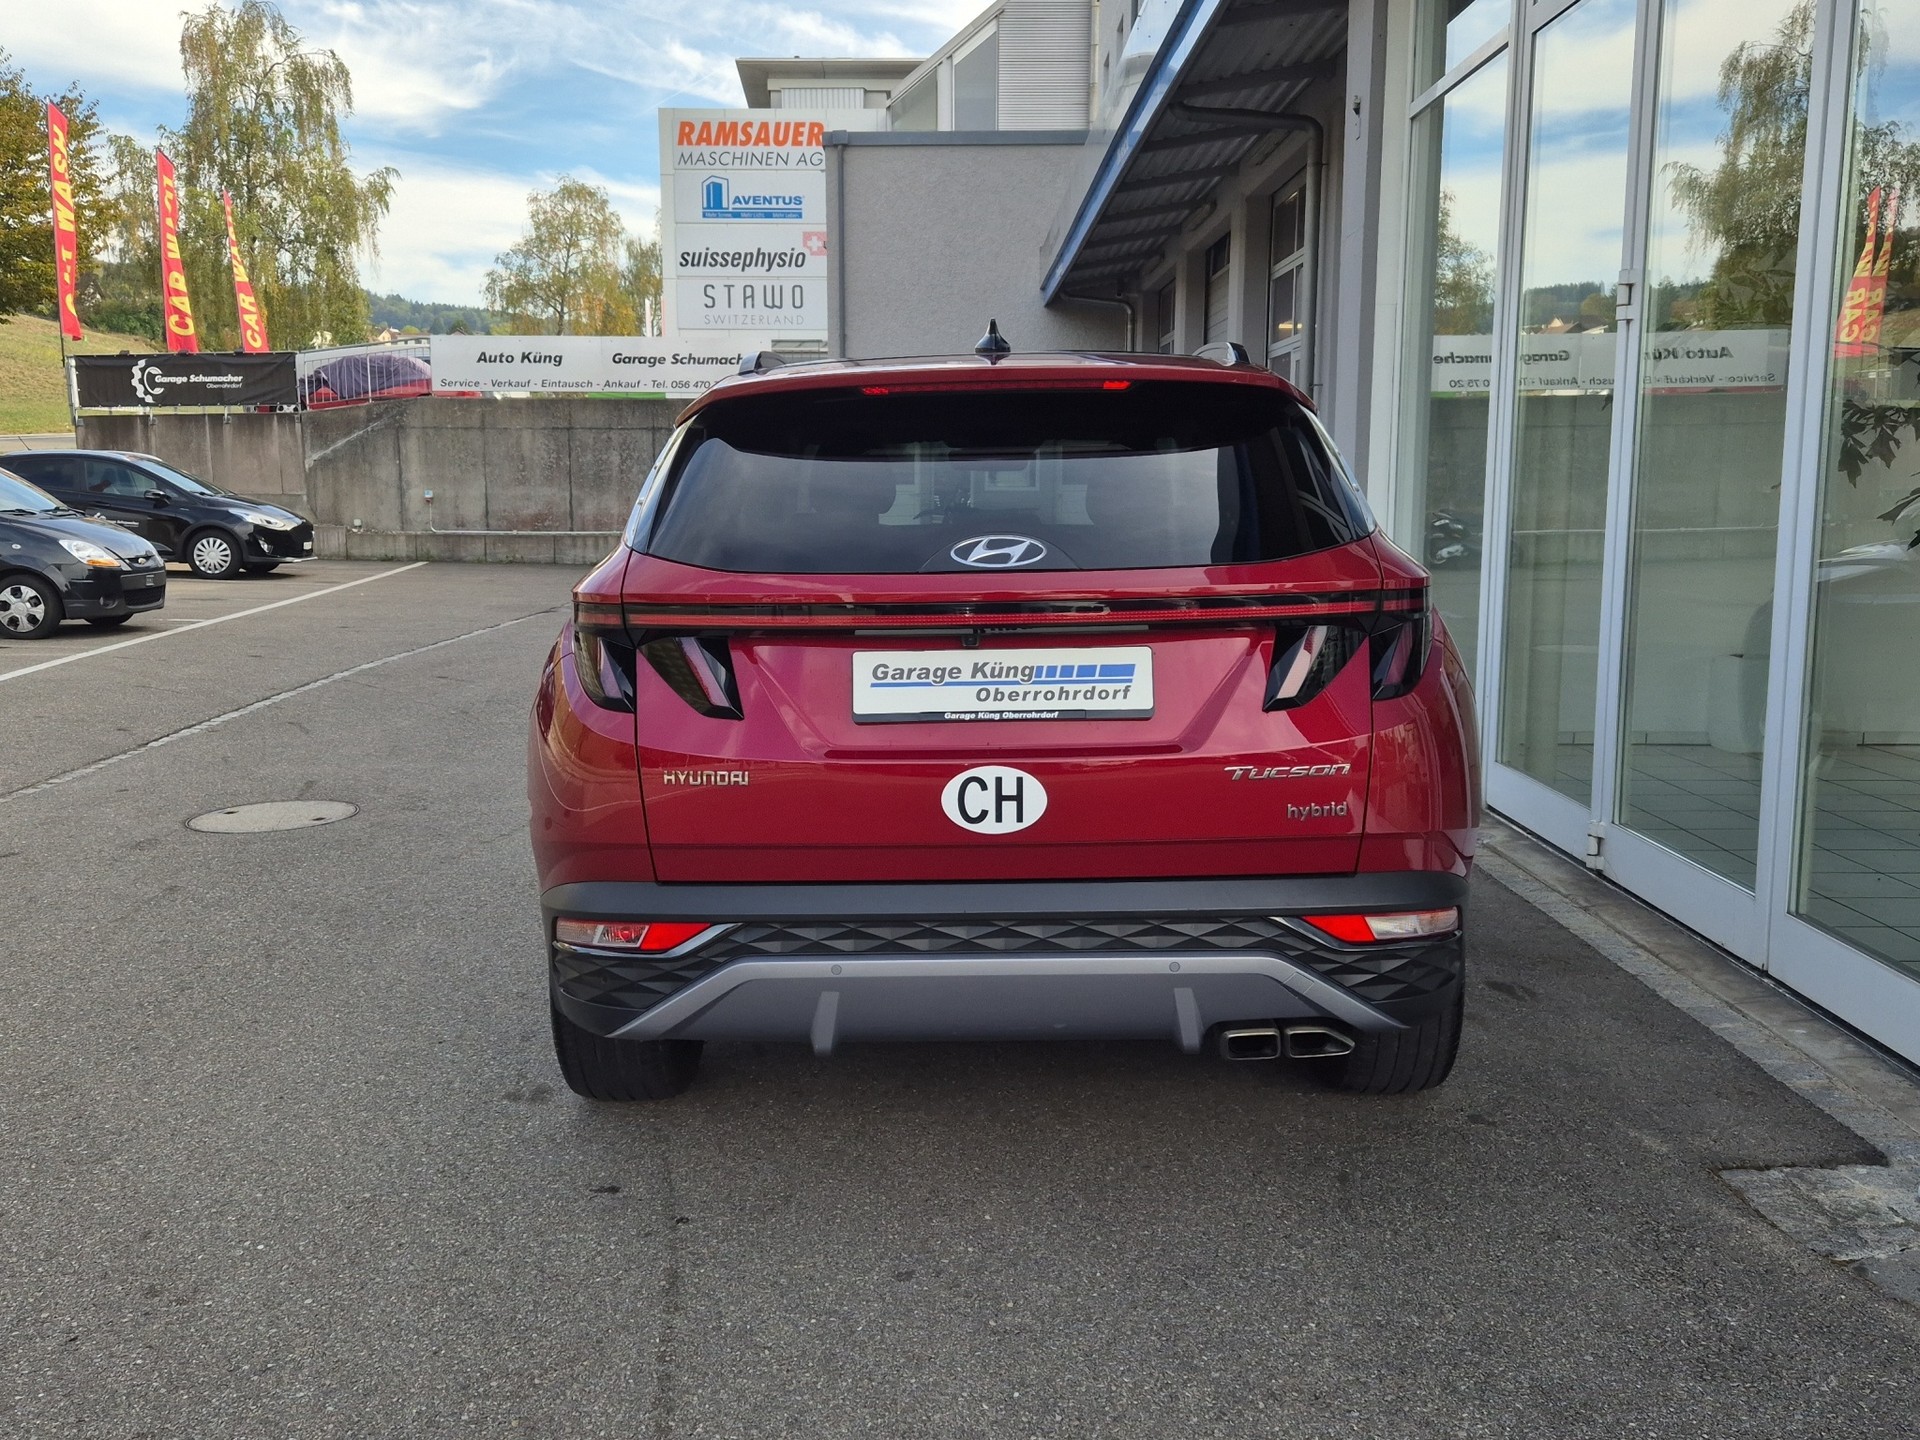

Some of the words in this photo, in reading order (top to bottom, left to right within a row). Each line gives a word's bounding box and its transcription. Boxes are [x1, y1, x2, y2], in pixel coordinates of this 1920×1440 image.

[677, 121, 825, 147] RAMSAUER
[677, 151, 790, 166] MASCHINEN
[796, 151, 824, 166] AG
[732, 195, 803, 206] AVENTUS
[679, 247, 806, 272] suissephysio
[703, 284, 804, 309] STAWO
[239, 293, 263, 349] CAR
[704, 314, 804, 325] SWITZERLAND
[476, 351, 515, 364] Auto
[520, 351, 563, 367] Küng
[612, 352, 666, 368] Garage
[154, 374, 188, 384] Garage
[189, 374, 243, 383] Schumacher
[440, 379, 480, 388] Service
[490, 379, 531, 388] Verkauf
[541, 379, 593, 388] Eintausch
[603, 380, 640, 389] Ankauf
[651, 380, 668, 389] Tel.
[671, 380, 690, 389] 056
[692, 380, 711, 389] 470
[871, 663, 962, 684] Garage
[970, 661, 1035, 683] Küng
[975, 685, 1132, 702] Oberrohrdorf
[944, 712, 975, 720] Garage
[978, 711, 1000, 720] Küng
[1002, 711, 1059, 719] Oberrohrdorf
[663, 770, 749, 786] HYUNDAI
[957, 775, 1024, 825] CH
[1287, 801, 1347, 821] hybrid
